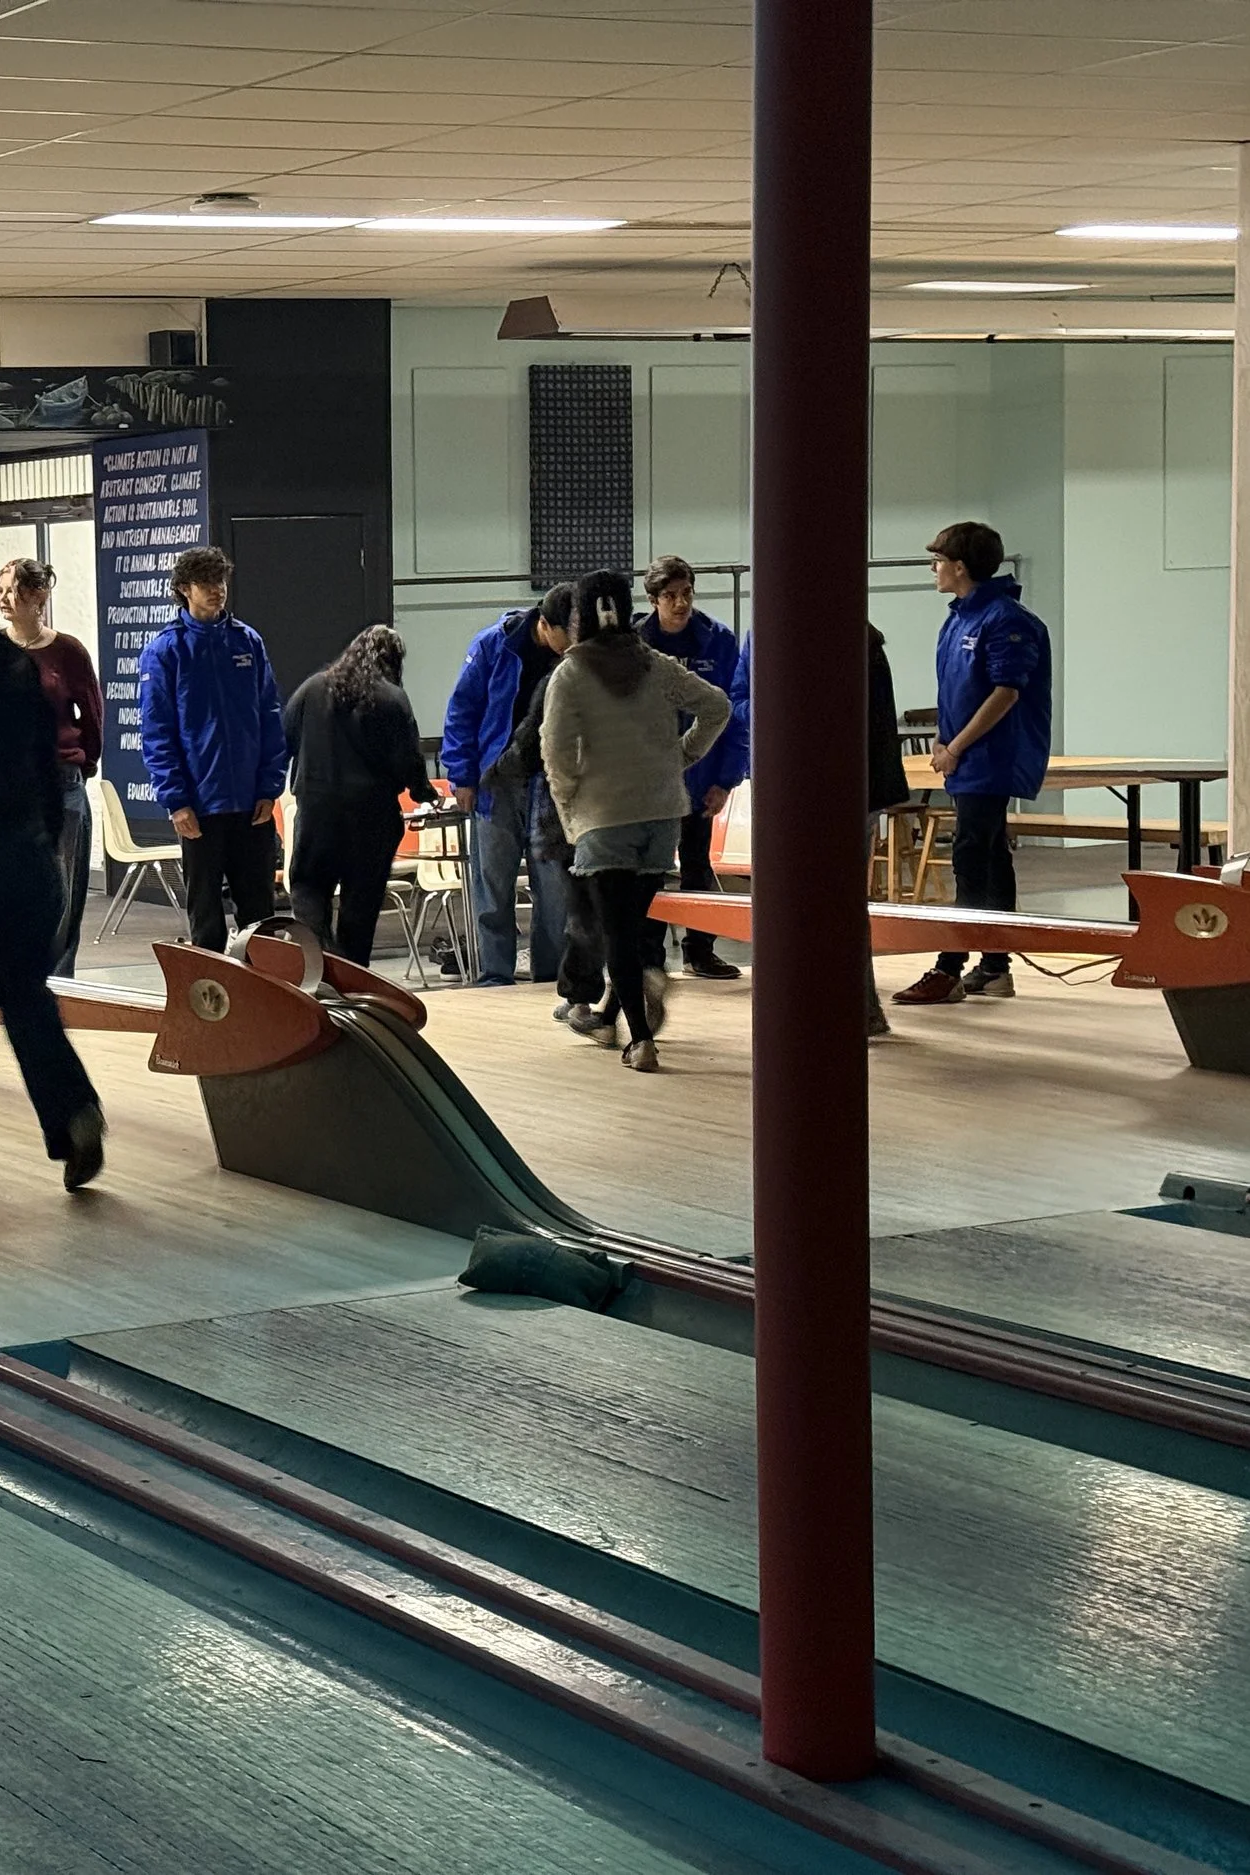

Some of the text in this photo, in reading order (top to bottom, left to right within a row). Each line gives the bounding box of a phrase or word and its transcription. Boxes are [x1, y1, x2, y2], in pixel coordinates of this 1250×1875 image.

[136, 449, 162, 469] ACTION
[162, 448, 170, 466] IS
[171, 446, 187, 465] NOT
[187, 444, 198, 463] AN
[100, 470, 202, 498] ABSTRACT CONCEPT. CLIMATE
[104, 498, 198, 523] ACTION IS SUSTAINABLE SOIL
[101, 524, 201, 549] AND NUTRIENT MANAGEMENT
[115, 552, 181, 573] IT IS ANIMAL HEALT
[120, 578, 163, 598] SUSTAINABLE
[107, 606, 148, 624] PRODUCTION
[115, 632, 122, 649] IT
[122, 632, 129, 649] IS
[130, 631, 143, 649] THE
[117, 656, 139, 674] KNOWL
[106, 682, 135, 700] DECISION
[118, 707, 142, 725] INDIGE
[121, 732, 143, 751] WOME
